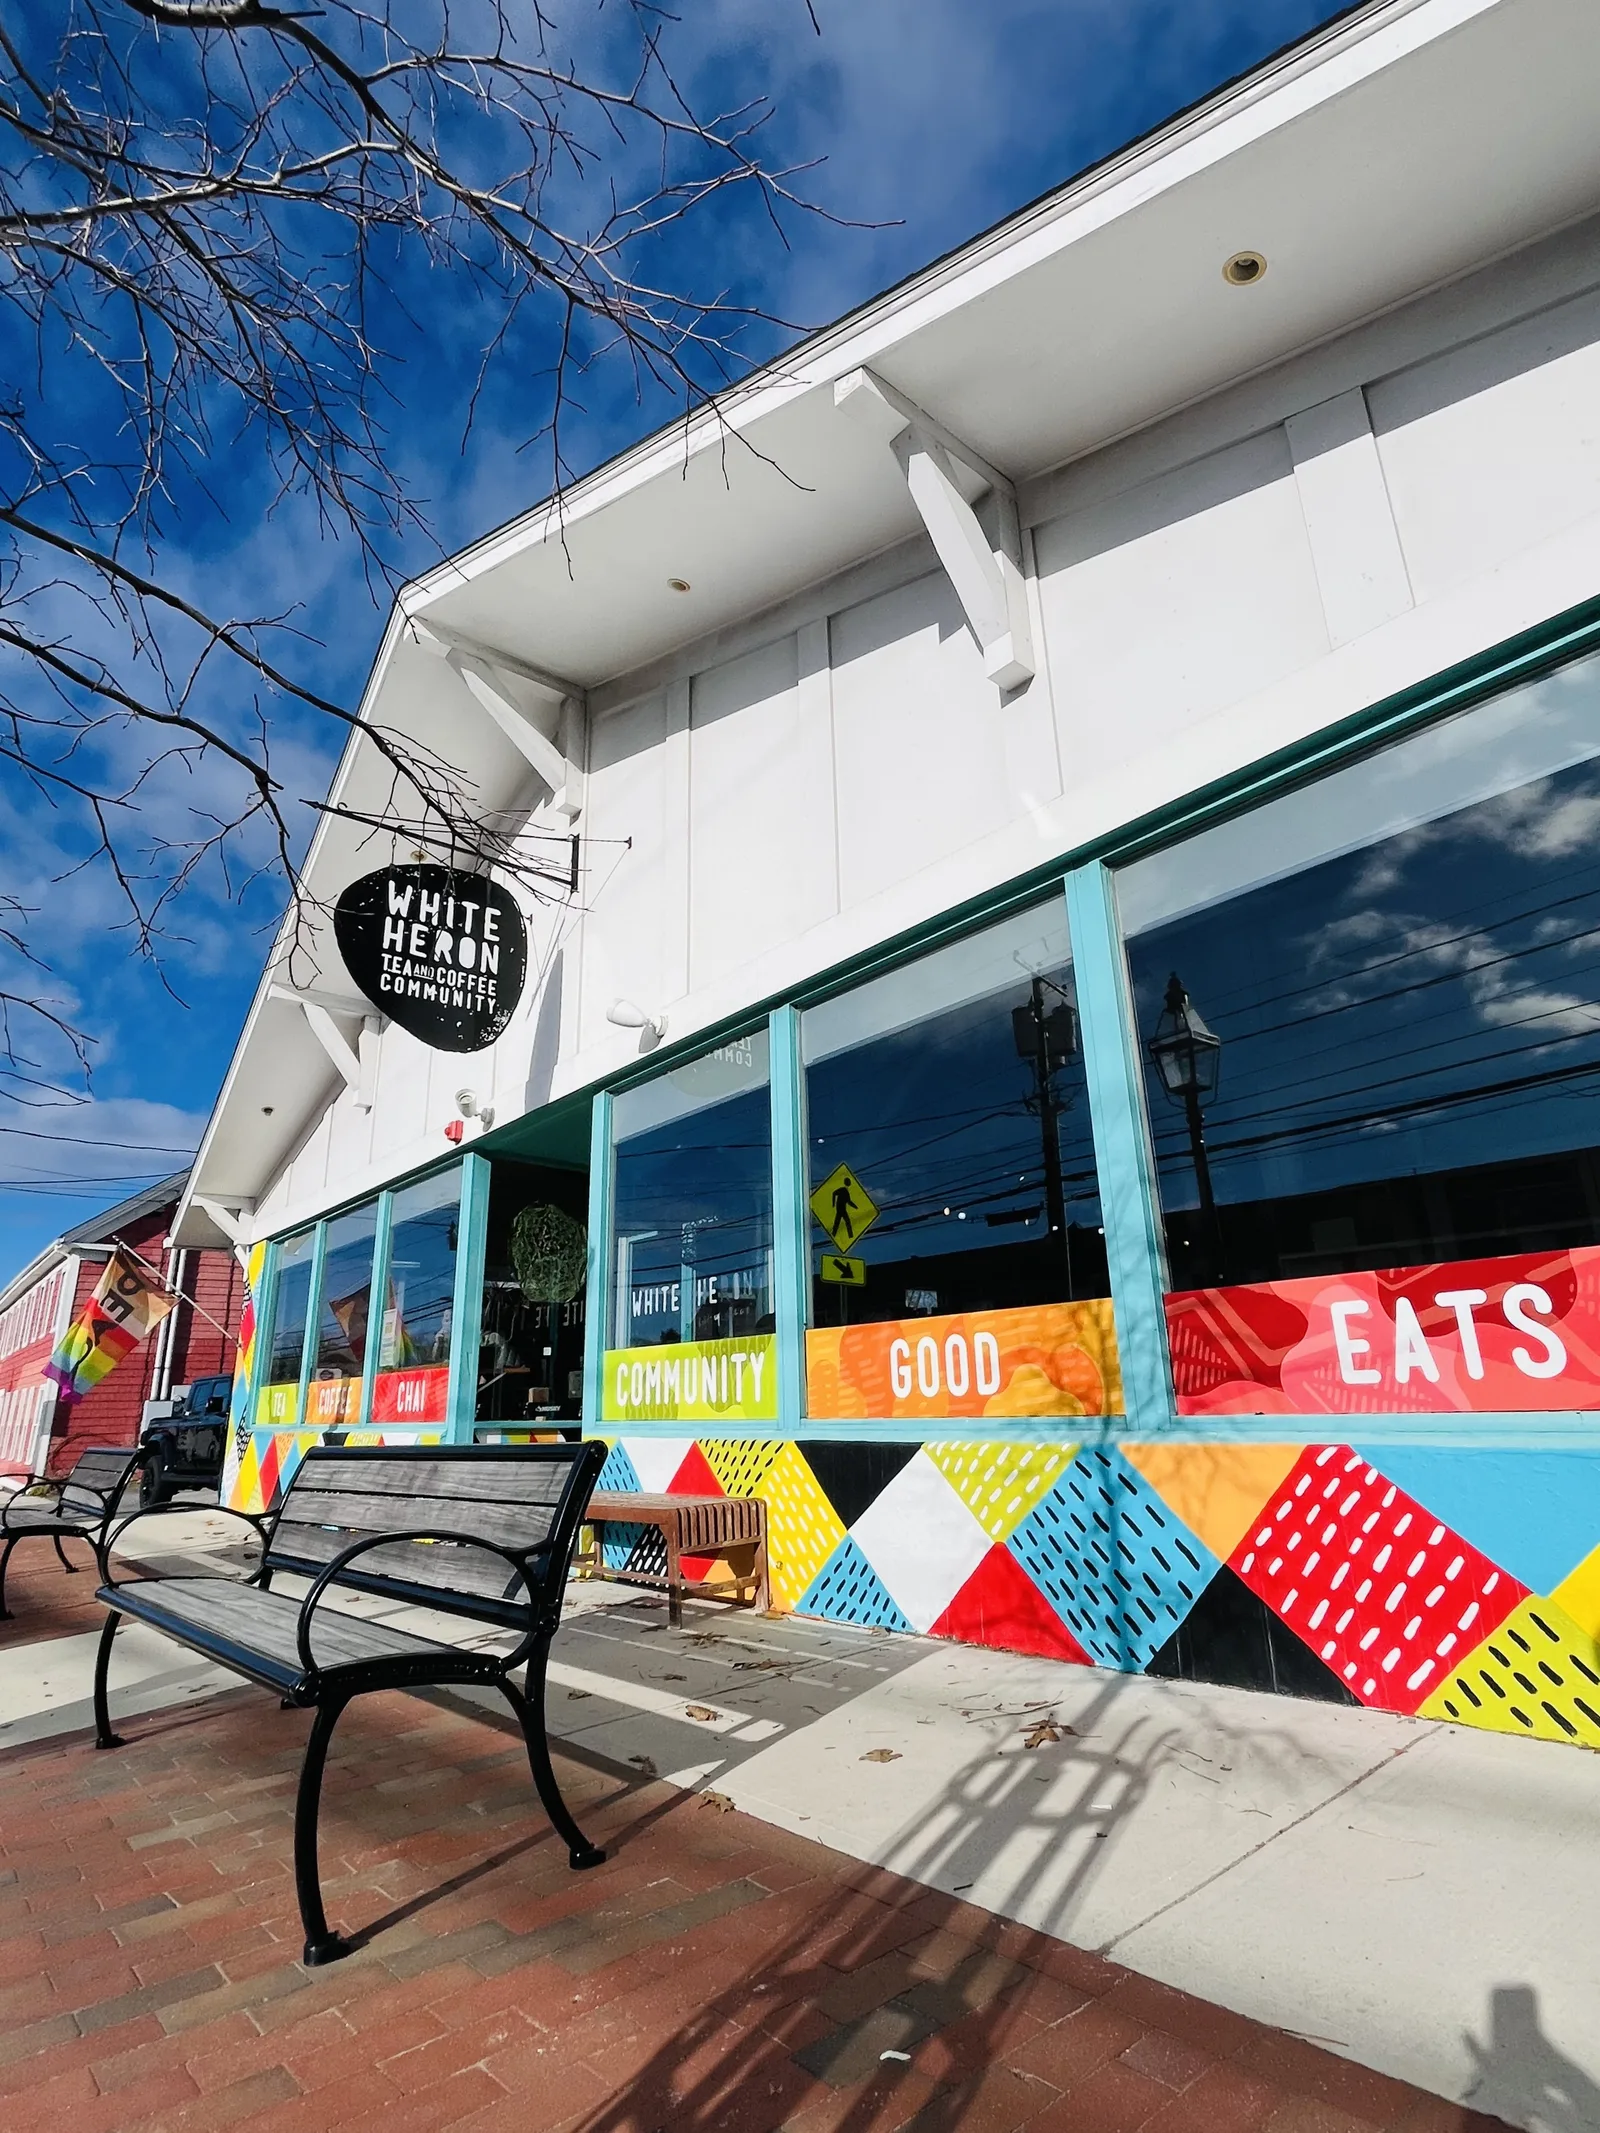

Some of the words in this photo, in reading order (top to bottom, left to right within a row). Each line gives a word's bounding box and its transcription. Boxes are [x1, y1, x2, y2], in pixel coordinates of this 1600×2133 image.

[388, 880, 502, 942] WHITE
[382, 916, 500, 975] HERON
[379, 975, 497, 1014] COMMUNITY
[381, 953, 412, 976] TEA
[413, 965, 434, 979] AND
[436, 966, 498, 996] COFFEE
[632, 1284, 680, 1317] WHITE
[1330, 1283, 1568, 1385] EATS
[616, 1351, 766, 1407] COMMUNITY
[890, 1331, 1001, 1398] GOOD
[273, 1392, 287, 1418] TEA
[318, 1388, 353, 1414] COFFEE
[397, 1380, 426, 1413] CHAI
